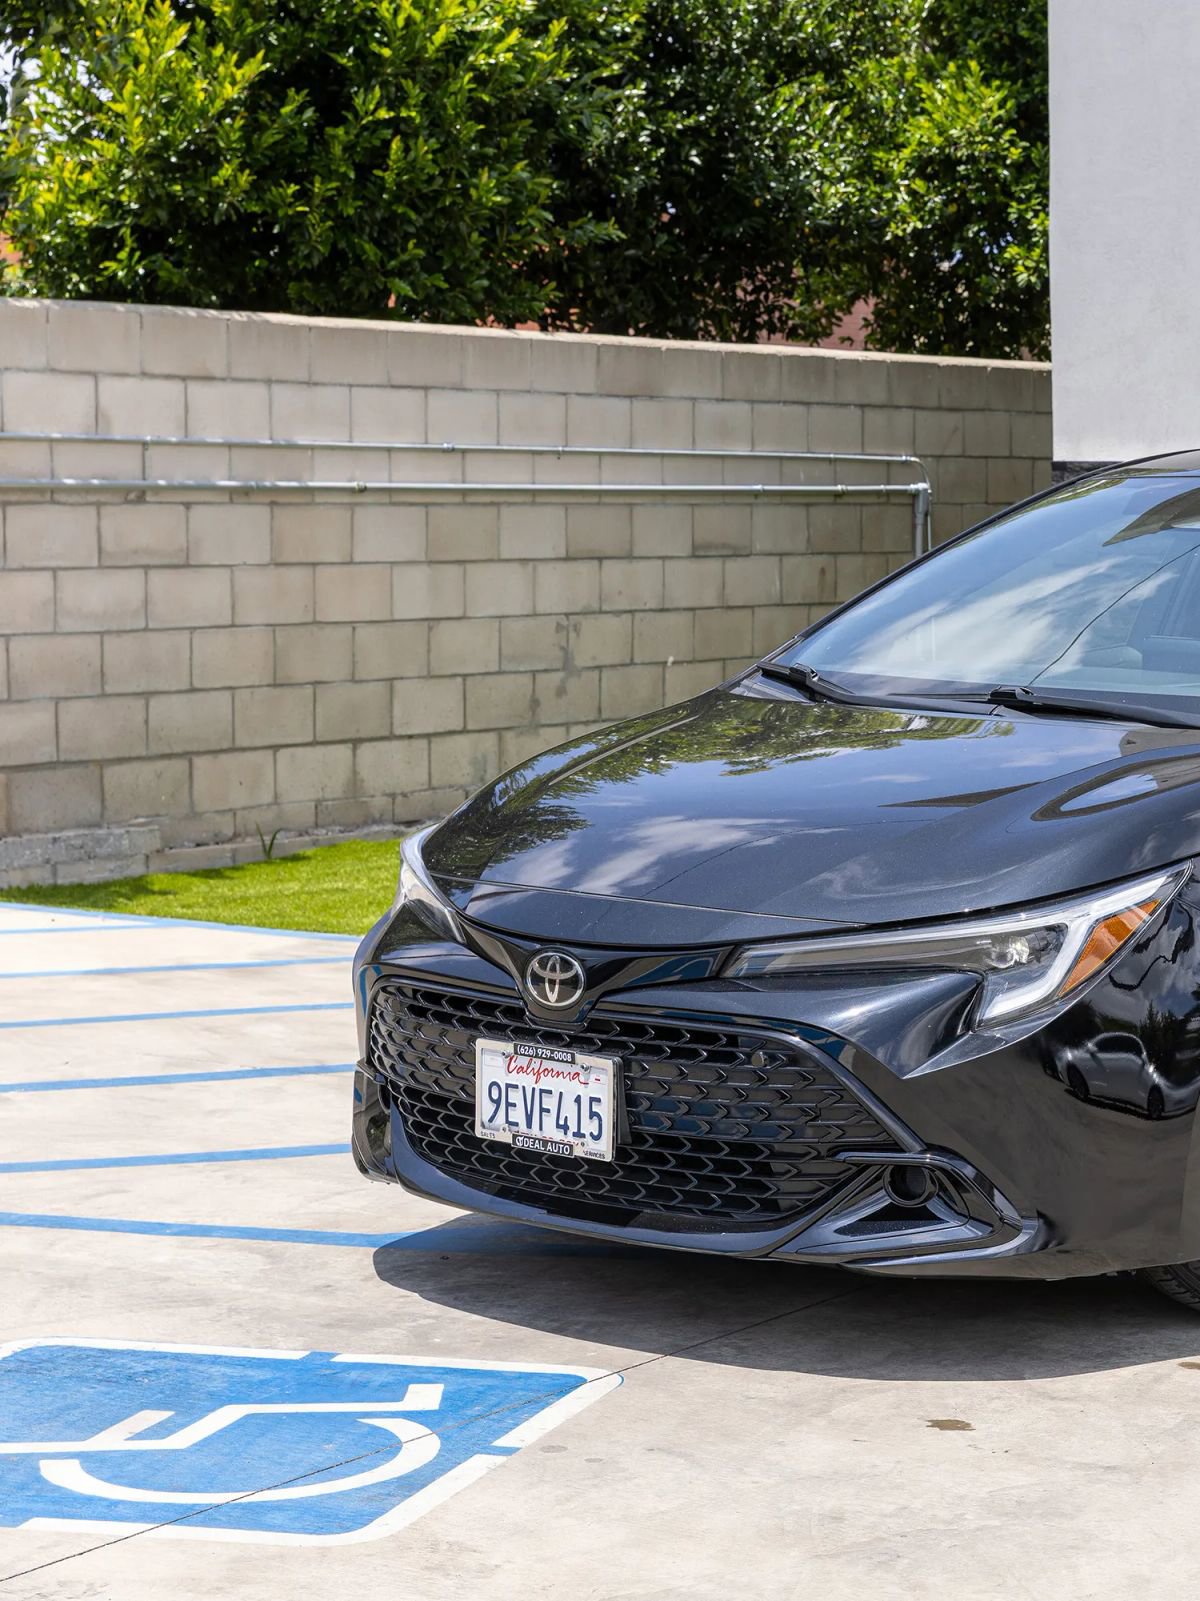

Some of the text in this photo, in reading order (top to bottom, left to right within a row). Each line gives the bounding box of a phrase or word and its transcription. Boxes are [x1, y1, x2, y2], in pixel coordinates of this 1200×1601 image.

[517, 1044, 572, 1062] (626) 929-0008
[506, 1055, 589, 1085] California
[487, 1080, 603, 1141] 9EVF415
[546, 1142, 570, 1155] AUTO
